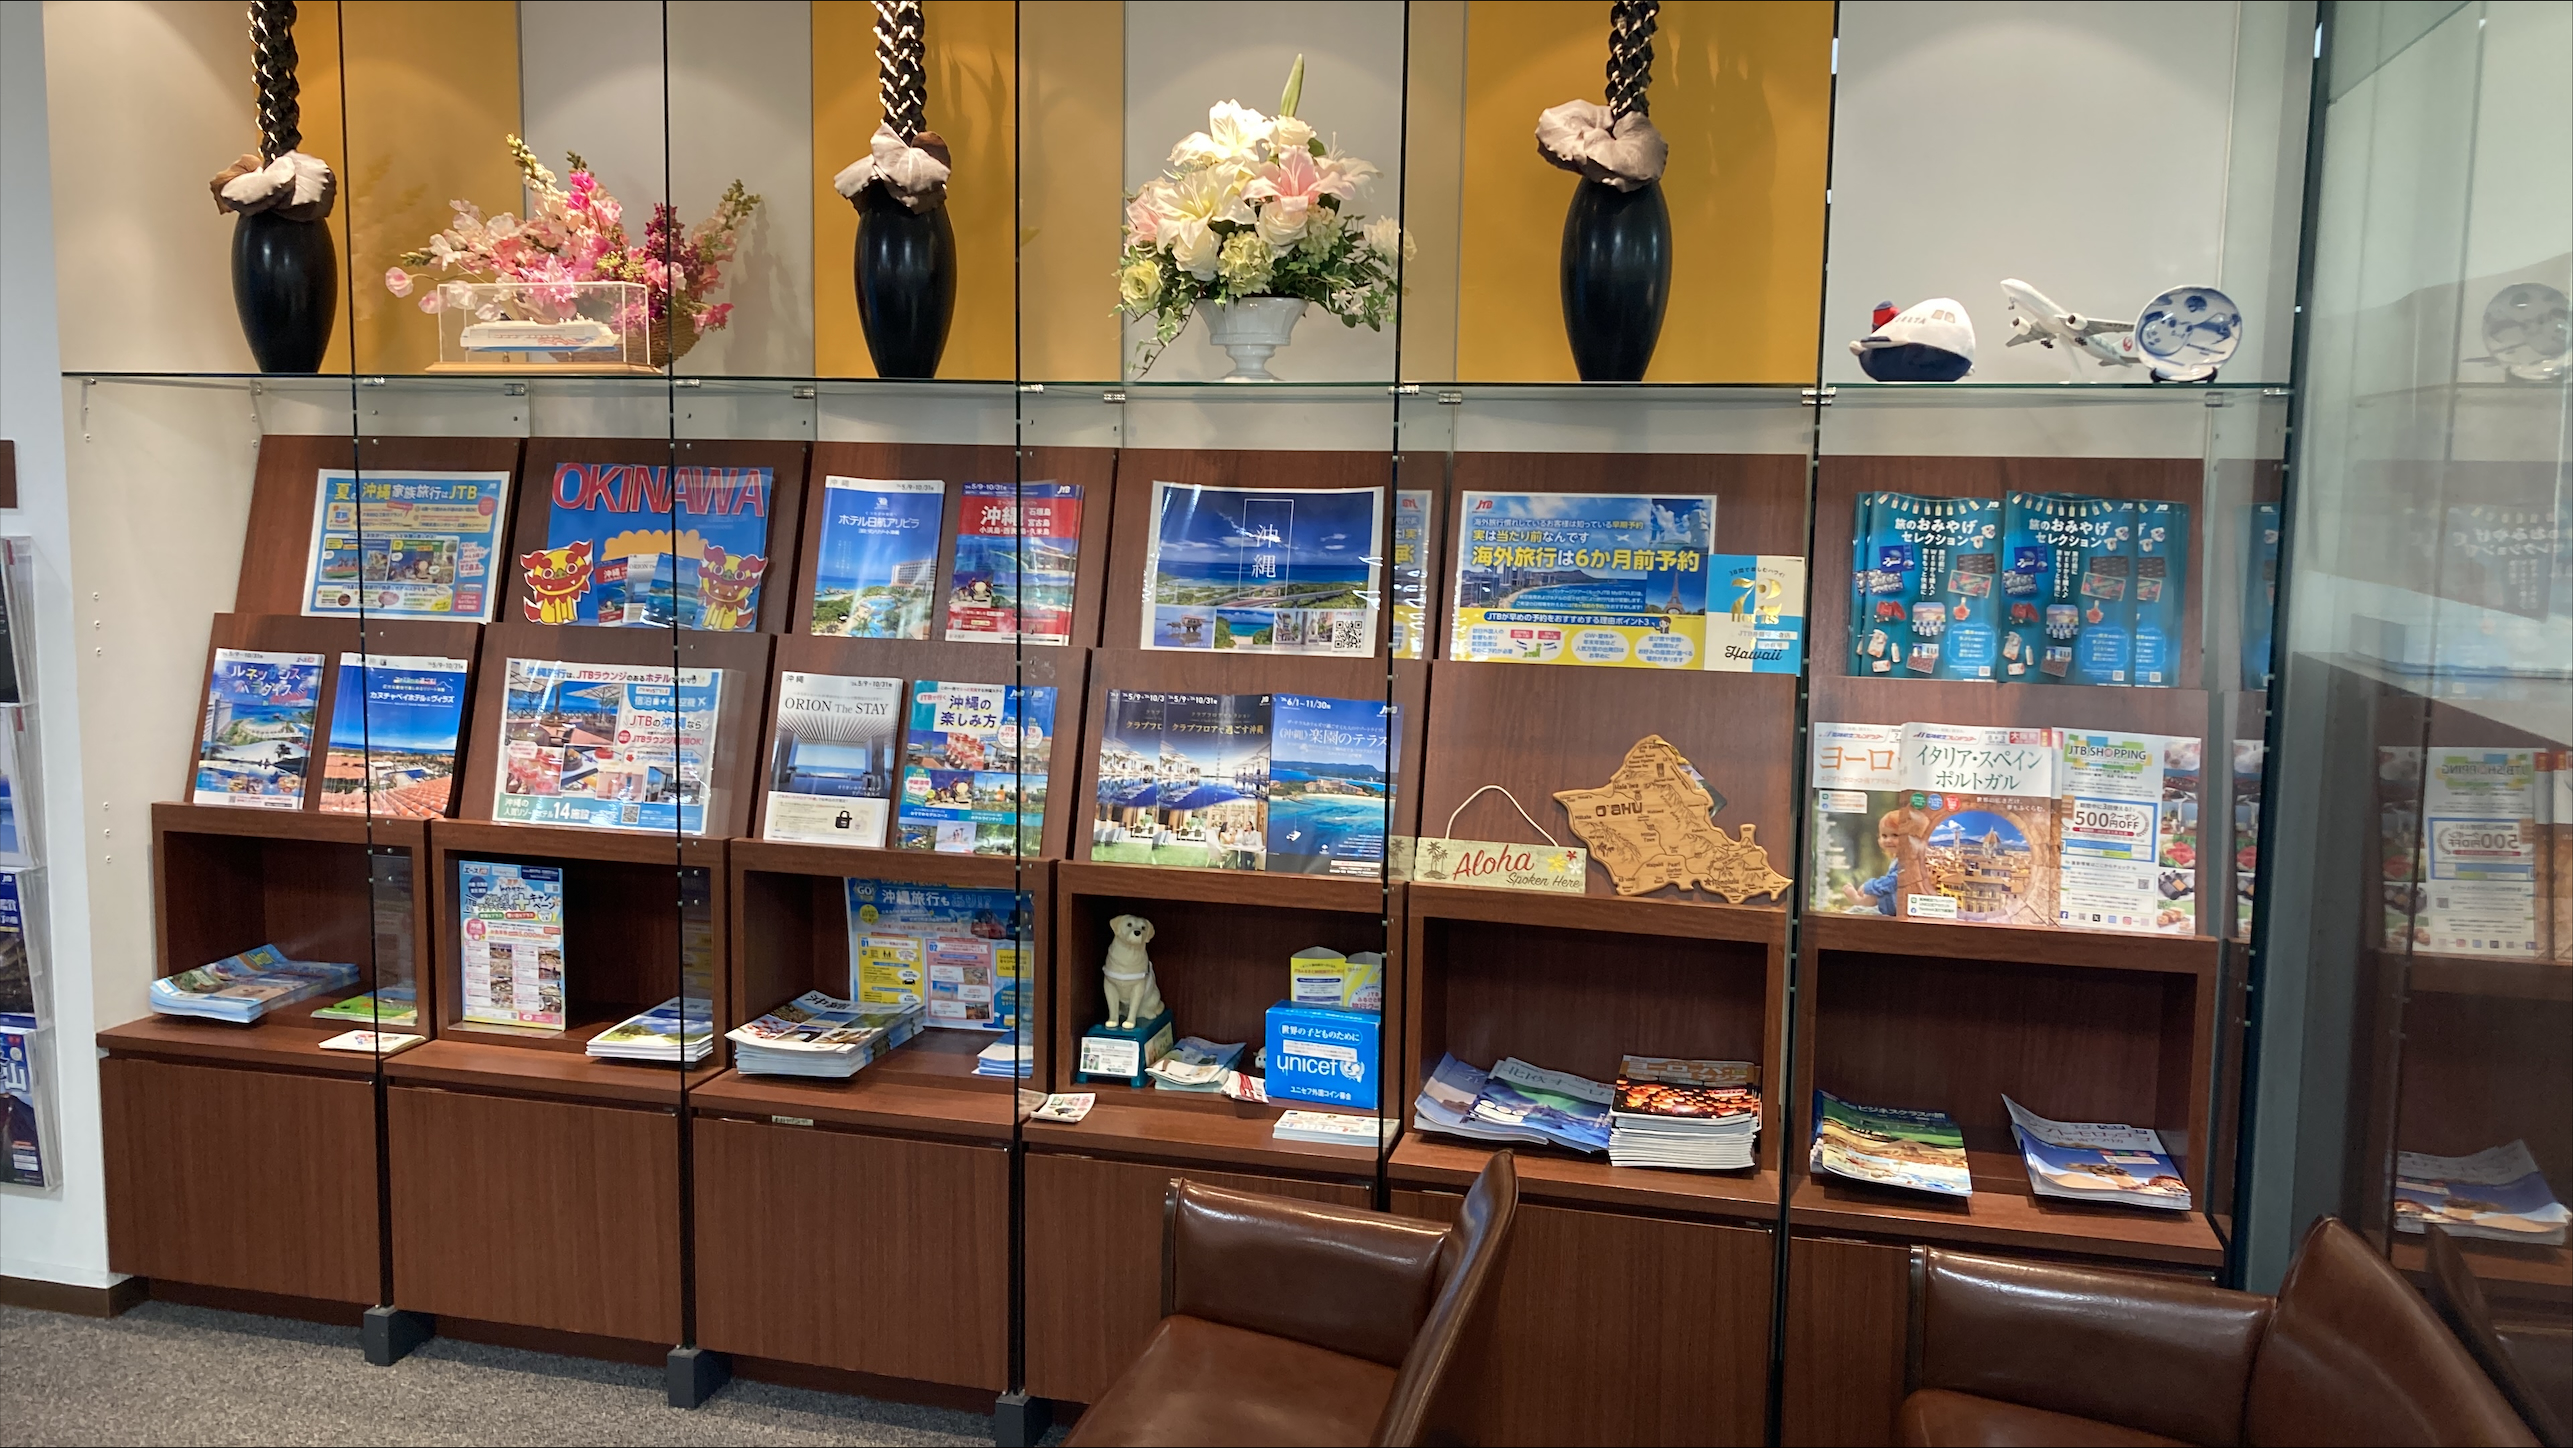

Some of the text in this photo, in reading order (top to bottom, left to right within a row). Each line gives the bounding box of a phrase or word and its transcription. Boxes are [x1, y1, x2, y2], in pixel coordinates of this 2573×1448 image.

[552, 462, 765, 517] OKINAWA
[1056, 485, 1071, 494] JTB
[1029, 507, 1051, 517] 石垣島
[1476, 500, 1493, 509] JTB
[838, 514, 920, 529] ホテル日航アリビラ
[980, 505, 1024, 526] 沖縄
[1027, 518, 1050, 527] 宮古島
[1474, 517, 1644, 530] 海外旅行慣れしているお客様は知っている早期予約
[1895, 518, 1978, 534] 旅のおみやげ
[2029, 518, 2111, 536] 旅のおみやげ
[1472, 529, 1590, 543] 実は当たり前なんです
[1902, 531, 1969, 546] セレクション
[2036, 532, 2102, 548] セレクション
[1251, 524, 1281, 579] 沖縄
[1472, 546, 1701, 573] 海外旅行は6か月前予約
[1725, 645, 1783, 660] Hawaii
[231, 665, 301, 680] ルネッサンス
[786, 675, 804, 684] 沖縄
[234, 680, 293, 696] パラダイス
[785, 697, 889, 716] ORION The STAY
[949, 695, 991, 711] 沖縄の
[940, 712, 997, 728] 楽しみ方
[1172, 723, 1264, 735] クラブフロアで過ごす沖縄
[1819, 746, 1901, 772] ヨーロ
[1915, 744, 2043, 772] イタリア・スペイン
[2068, 746, 2146, 760] JTB SHOPPING
[1935, 771, 2021, 791] ポルトガル
[2075, 811, 2109, 827] 500
[2110, 813, 2139, 821] クーポン
[2110, 820, 2139, 830] 円OFF
[1453, 844, 1535, 881] Aloha
[1506, 872, 1580, 888] Spoken Here
[861, 939, 869, 948] 01
[929, 943, 938, 952] 02
[1282, 1025, 1360, 1042] 世界の子どものために
[1277, 1055, 1338, 1076] unicef
[1290, 1086, 1352, 1100] ユニセフ外国コイン募金
[1857, 1105, 1946, 1119] ビジネスクラスの旅
